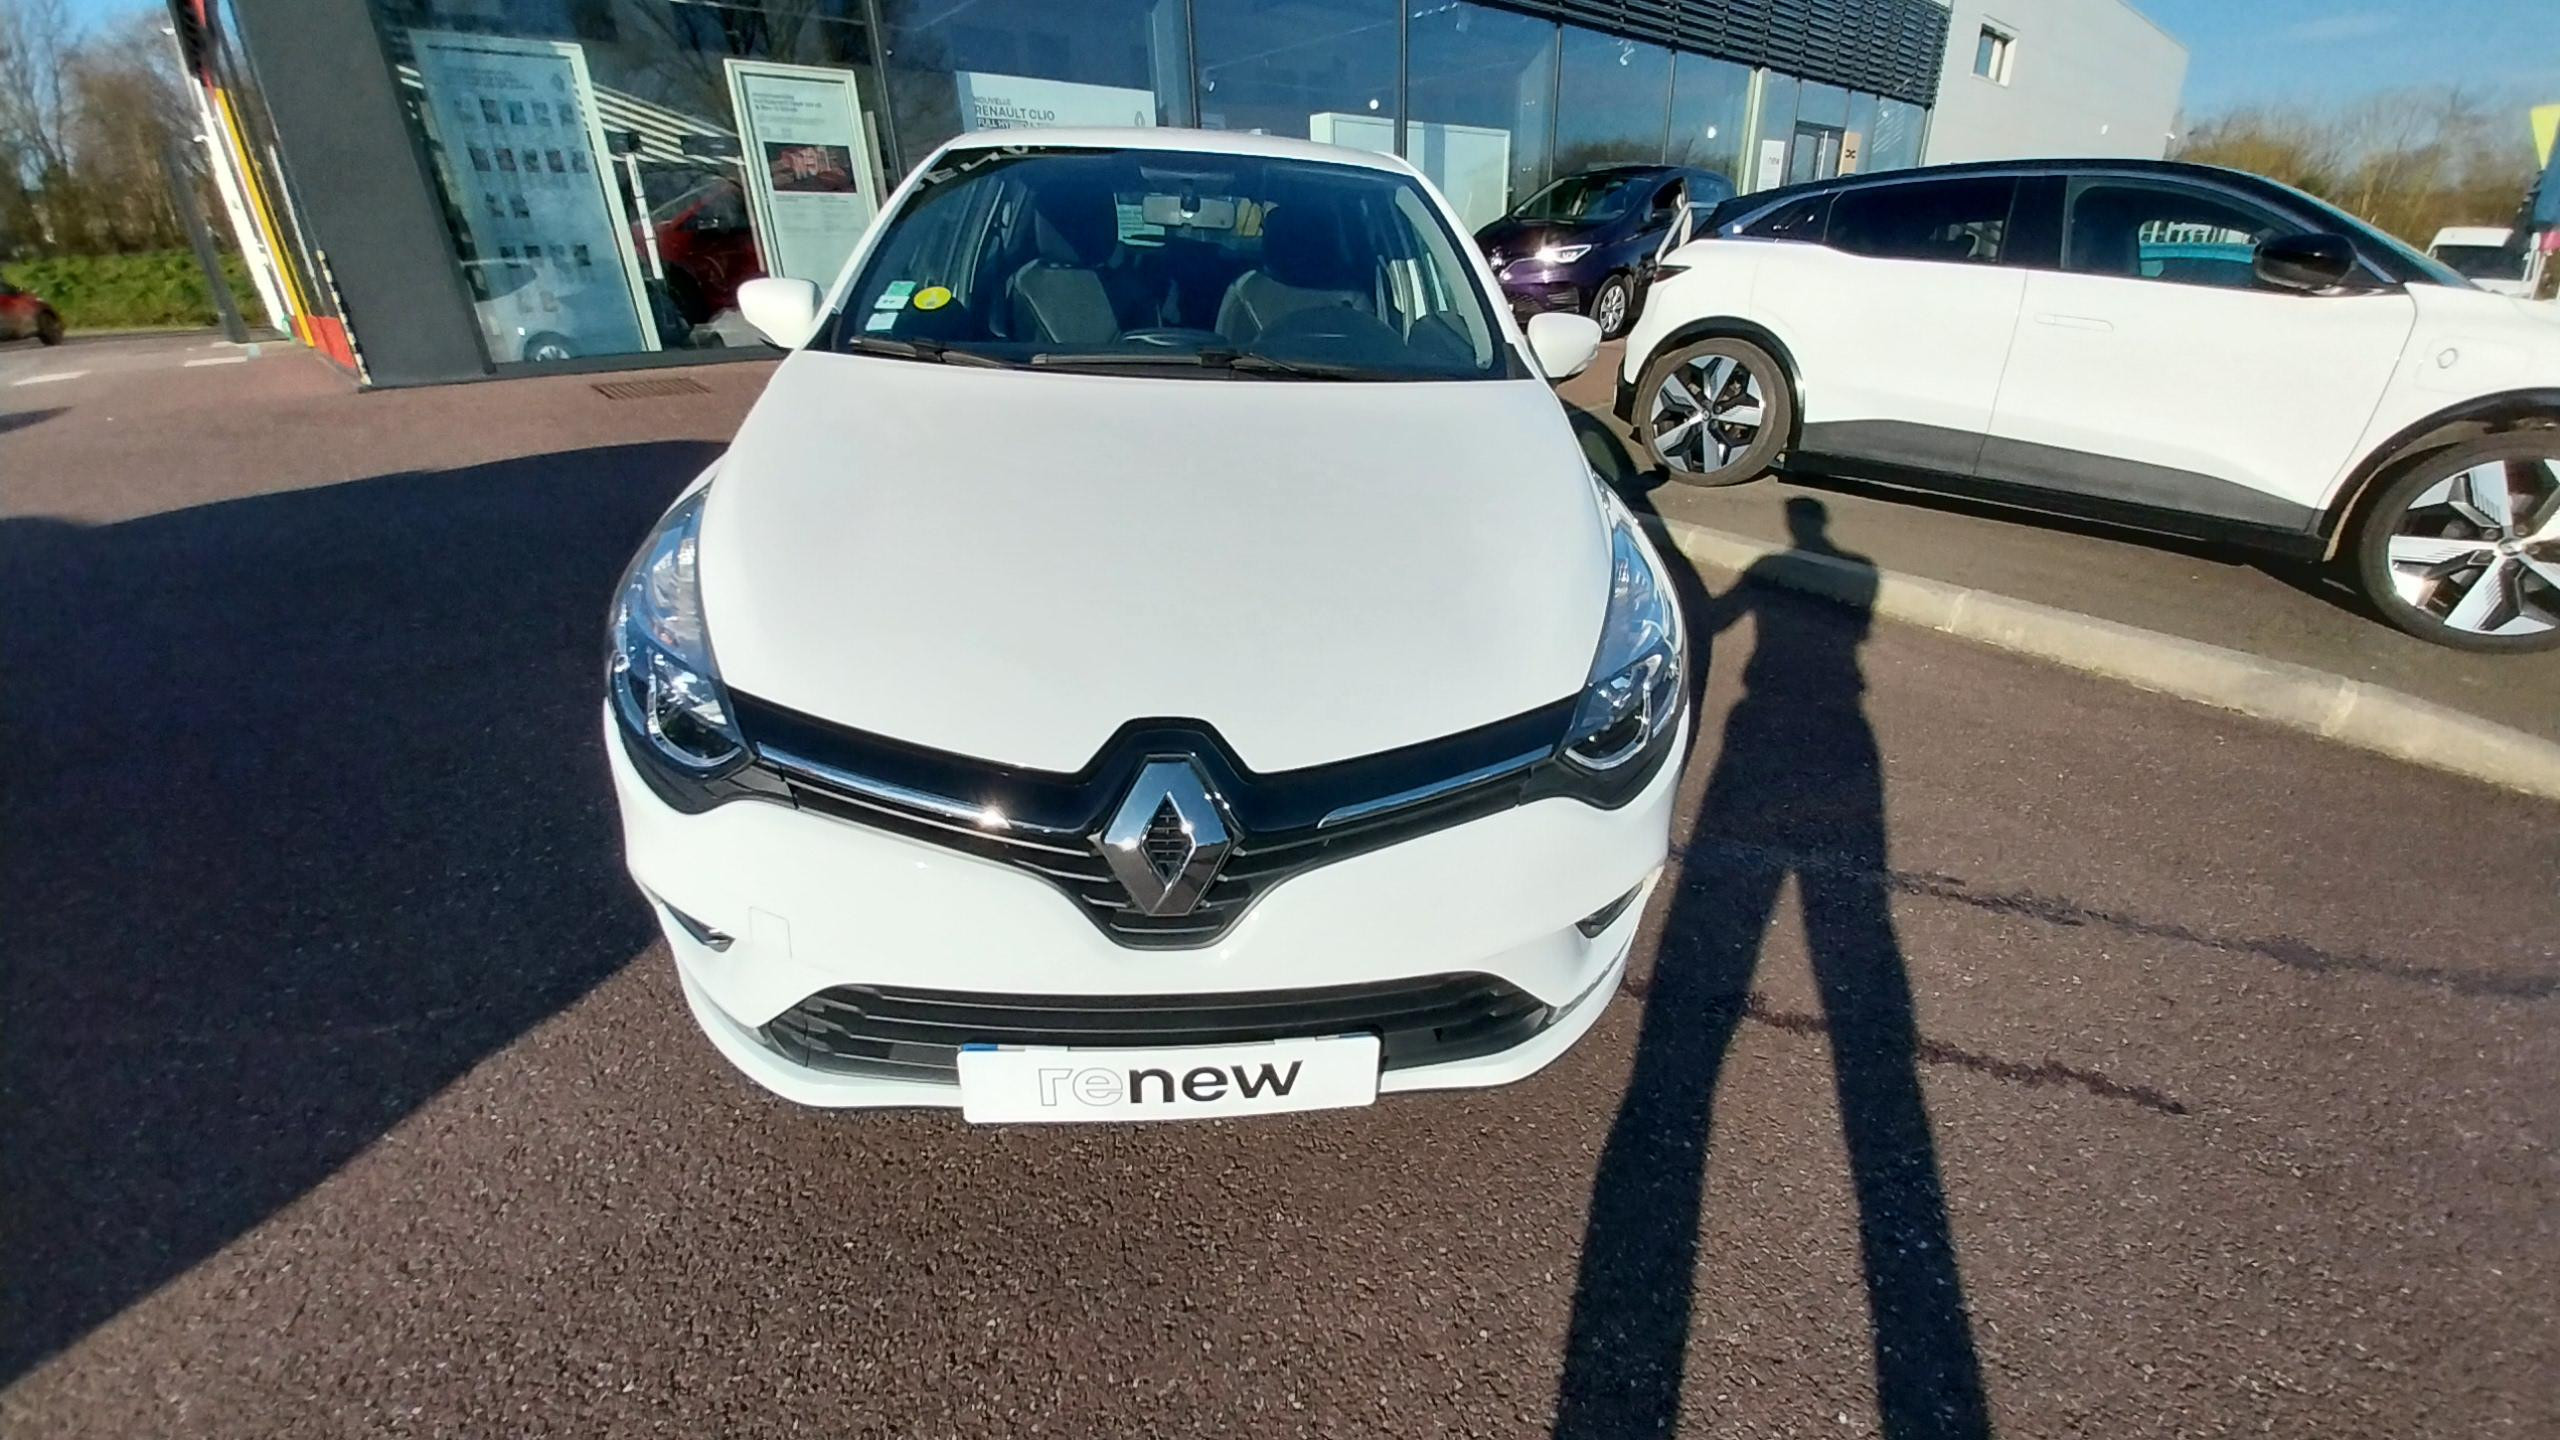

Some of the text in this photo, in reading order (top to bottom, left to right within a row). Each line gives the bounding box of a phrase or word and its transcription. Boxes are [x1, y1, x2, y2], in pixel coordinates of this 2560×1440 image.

[974, 105, 1055, 121] RENAULT CLIO
[1037, 1059, 1304, 1107] renew
